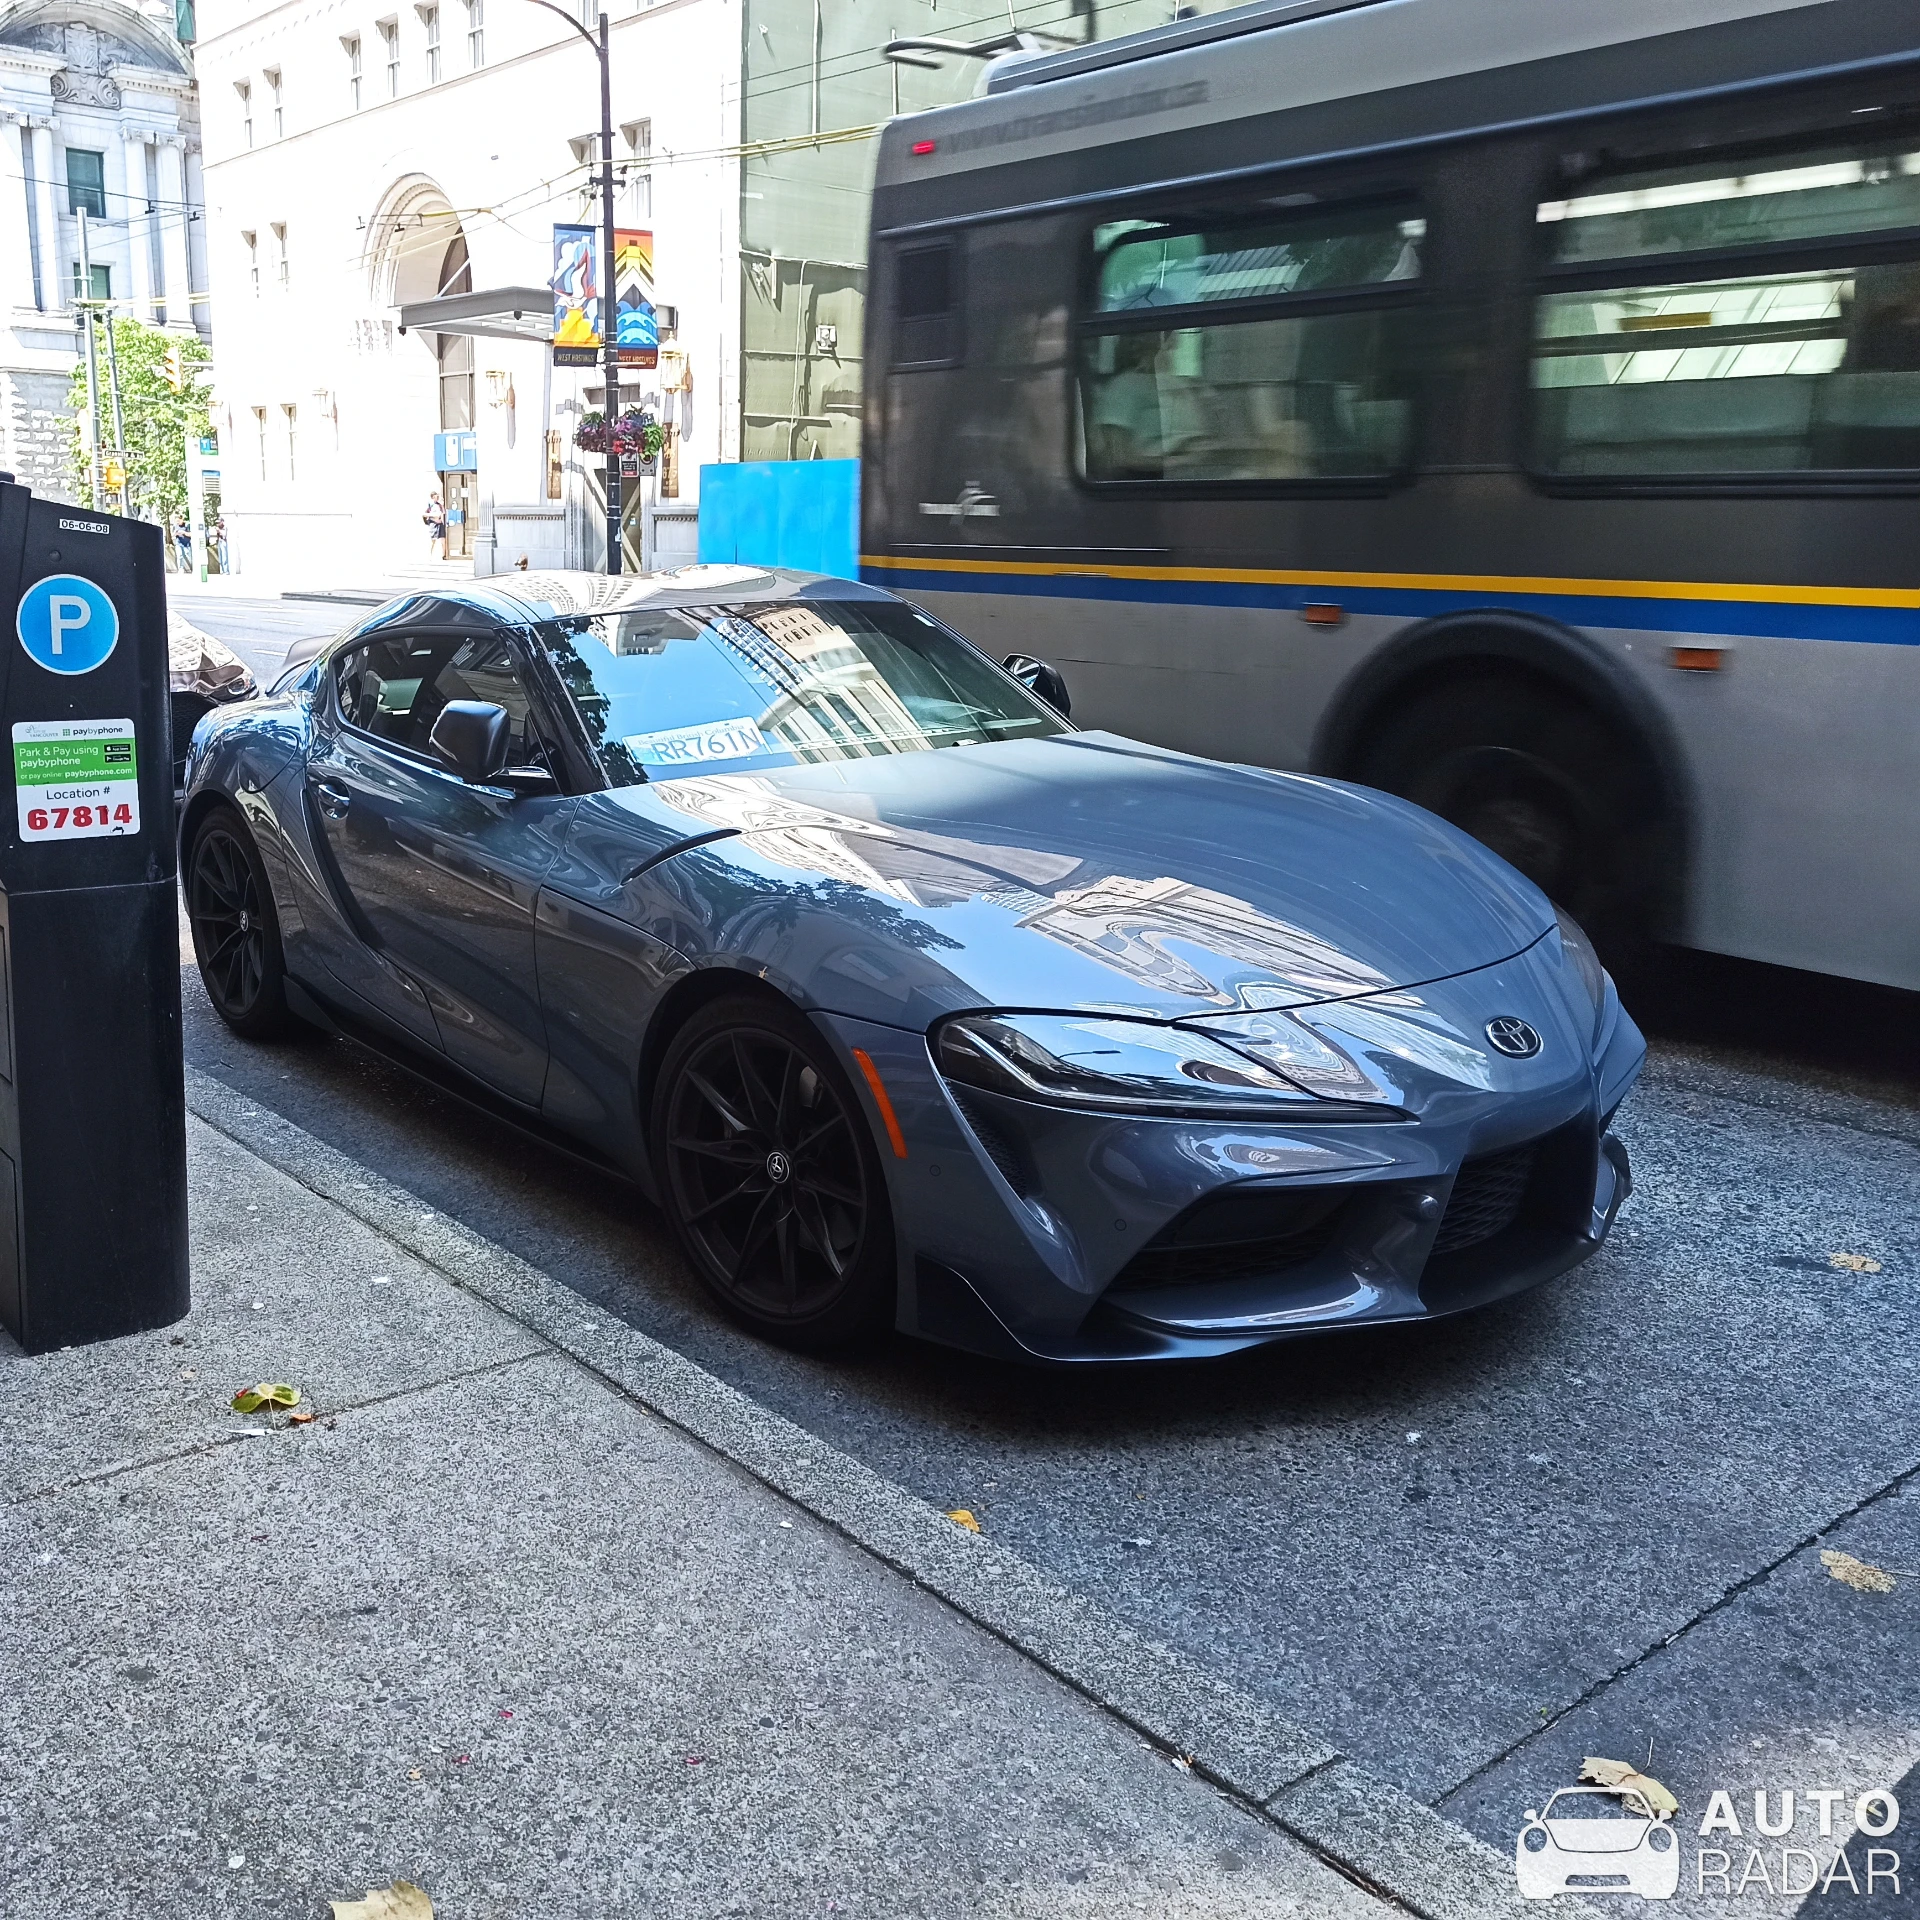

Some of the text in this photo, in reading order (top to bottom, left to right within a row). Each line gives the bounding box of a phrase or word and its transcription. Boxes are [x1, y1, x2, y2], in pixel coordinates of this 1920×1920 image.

[61, 519, 108, 533] 06-06-08
[50, 594, 92, 655] P
[73, 727, 123, 736] paybyphone
[638, 724, 744, 746] Beautiful British Columbia
[19, 746, 99, 758] Park & Pay using
[20, 757, 81, 769] paybyphone
[64, 768, 133, 779] paybyphone.com
[46, 786, 111, 800] Location #
[27, 803, 133, 831] 67814
